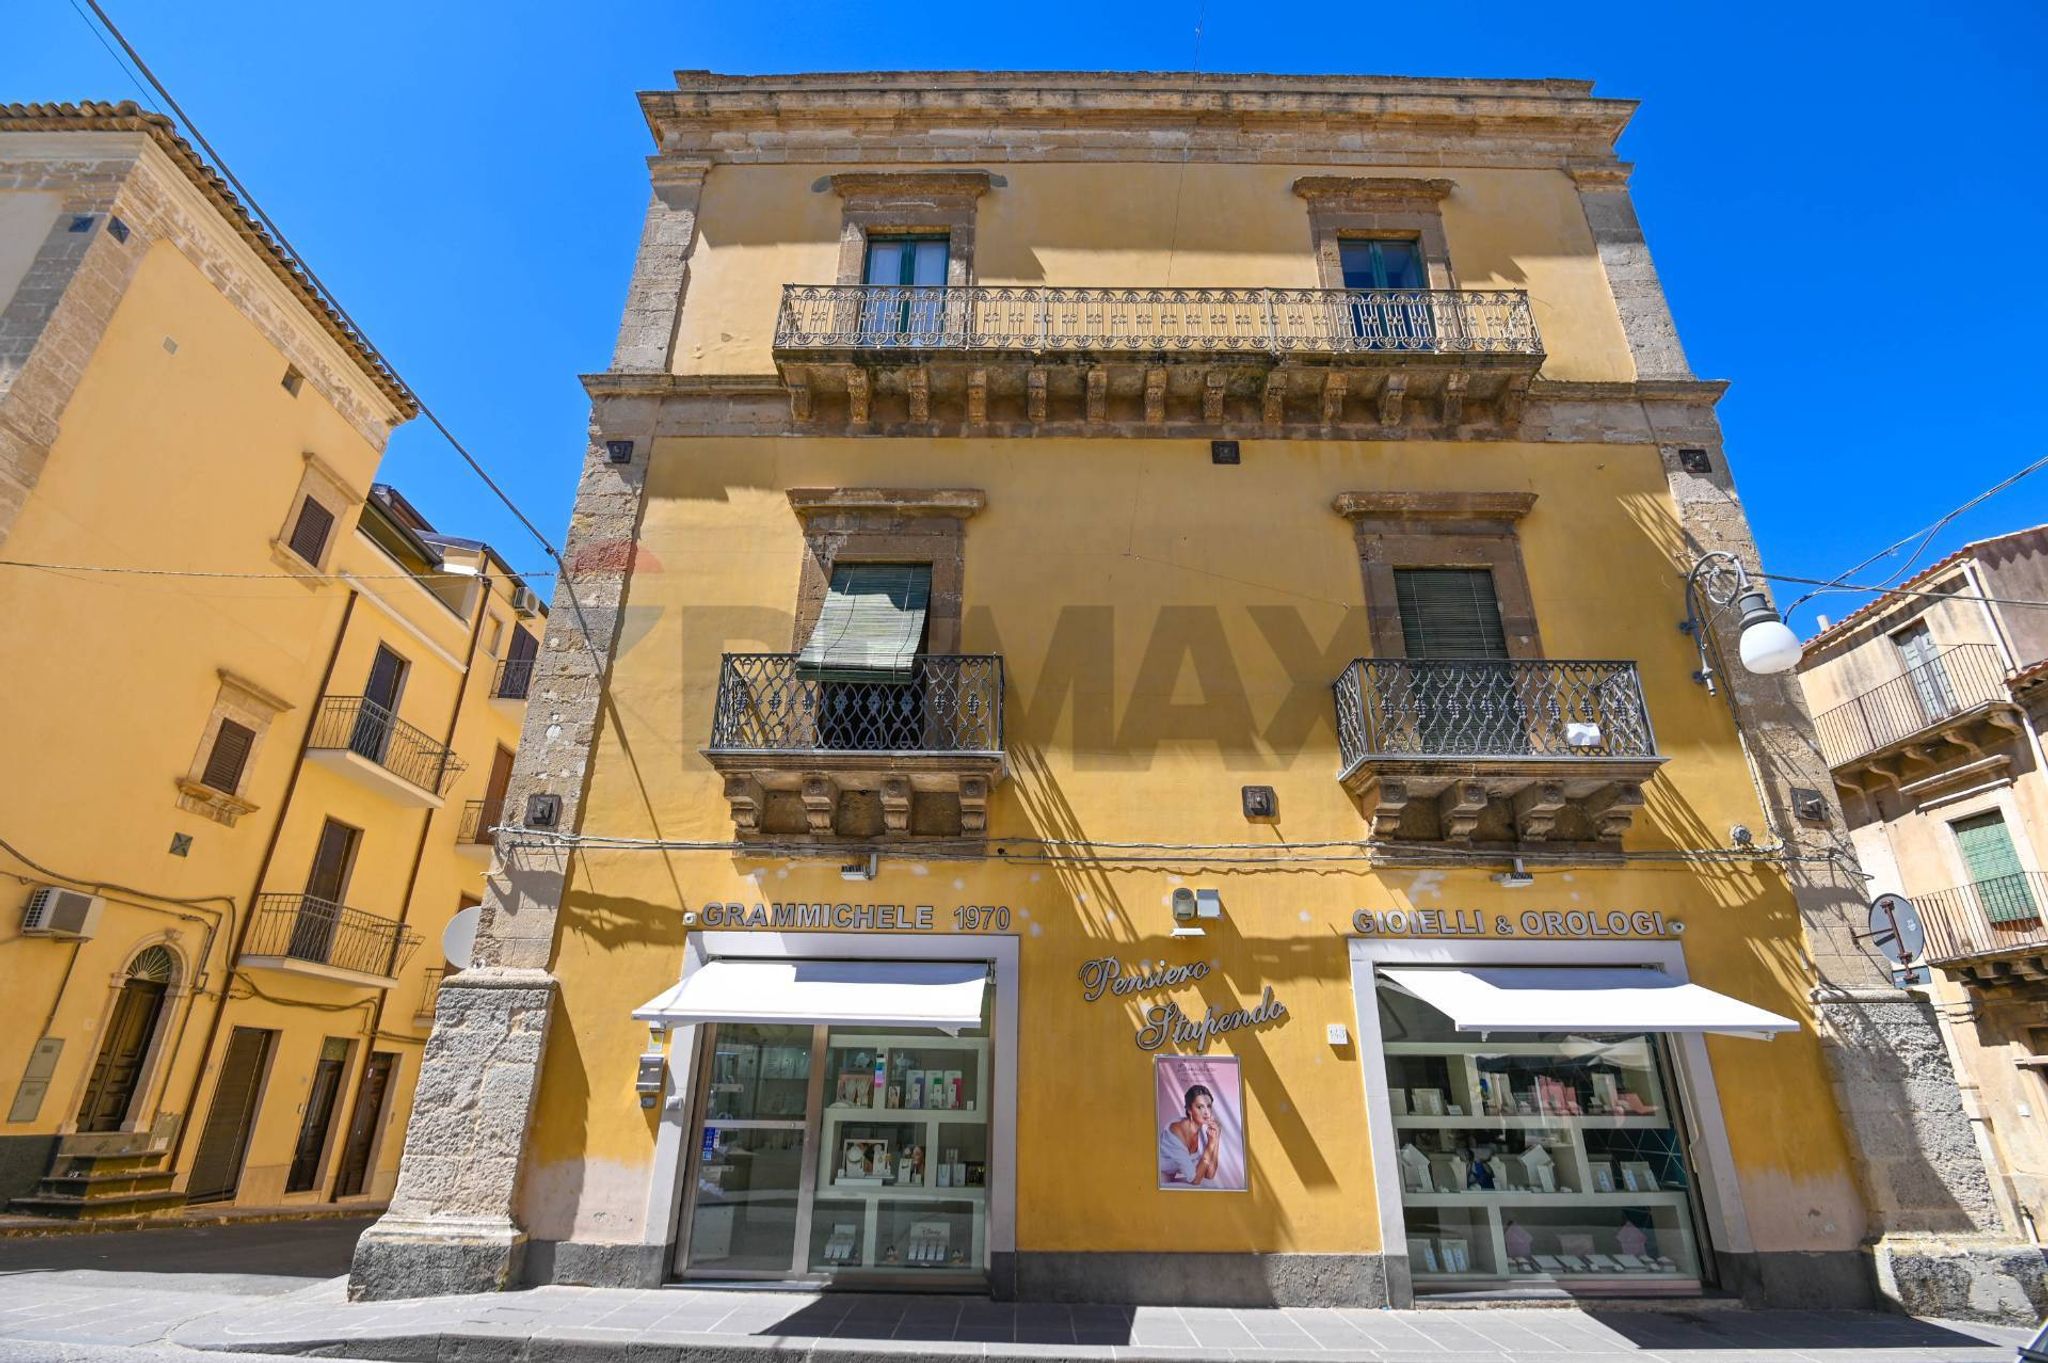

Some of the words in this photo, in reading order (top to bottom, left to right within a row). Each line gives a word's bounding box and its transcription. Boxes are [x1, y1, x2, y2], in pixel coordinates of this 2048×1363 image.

[702, 903, 933, 930] GRAMMICHELE
[953, 905, 1011, 931] 1970
[1352, 909, 1485, 935] GIOIELLI
[1495, 916, 1514, 935] &
[1520, 910, 1666, 936] OROLOGI
[1079, 956, 1210, 1002] Pensiero
[1135, 985, 1285, 1054] Stupendo
